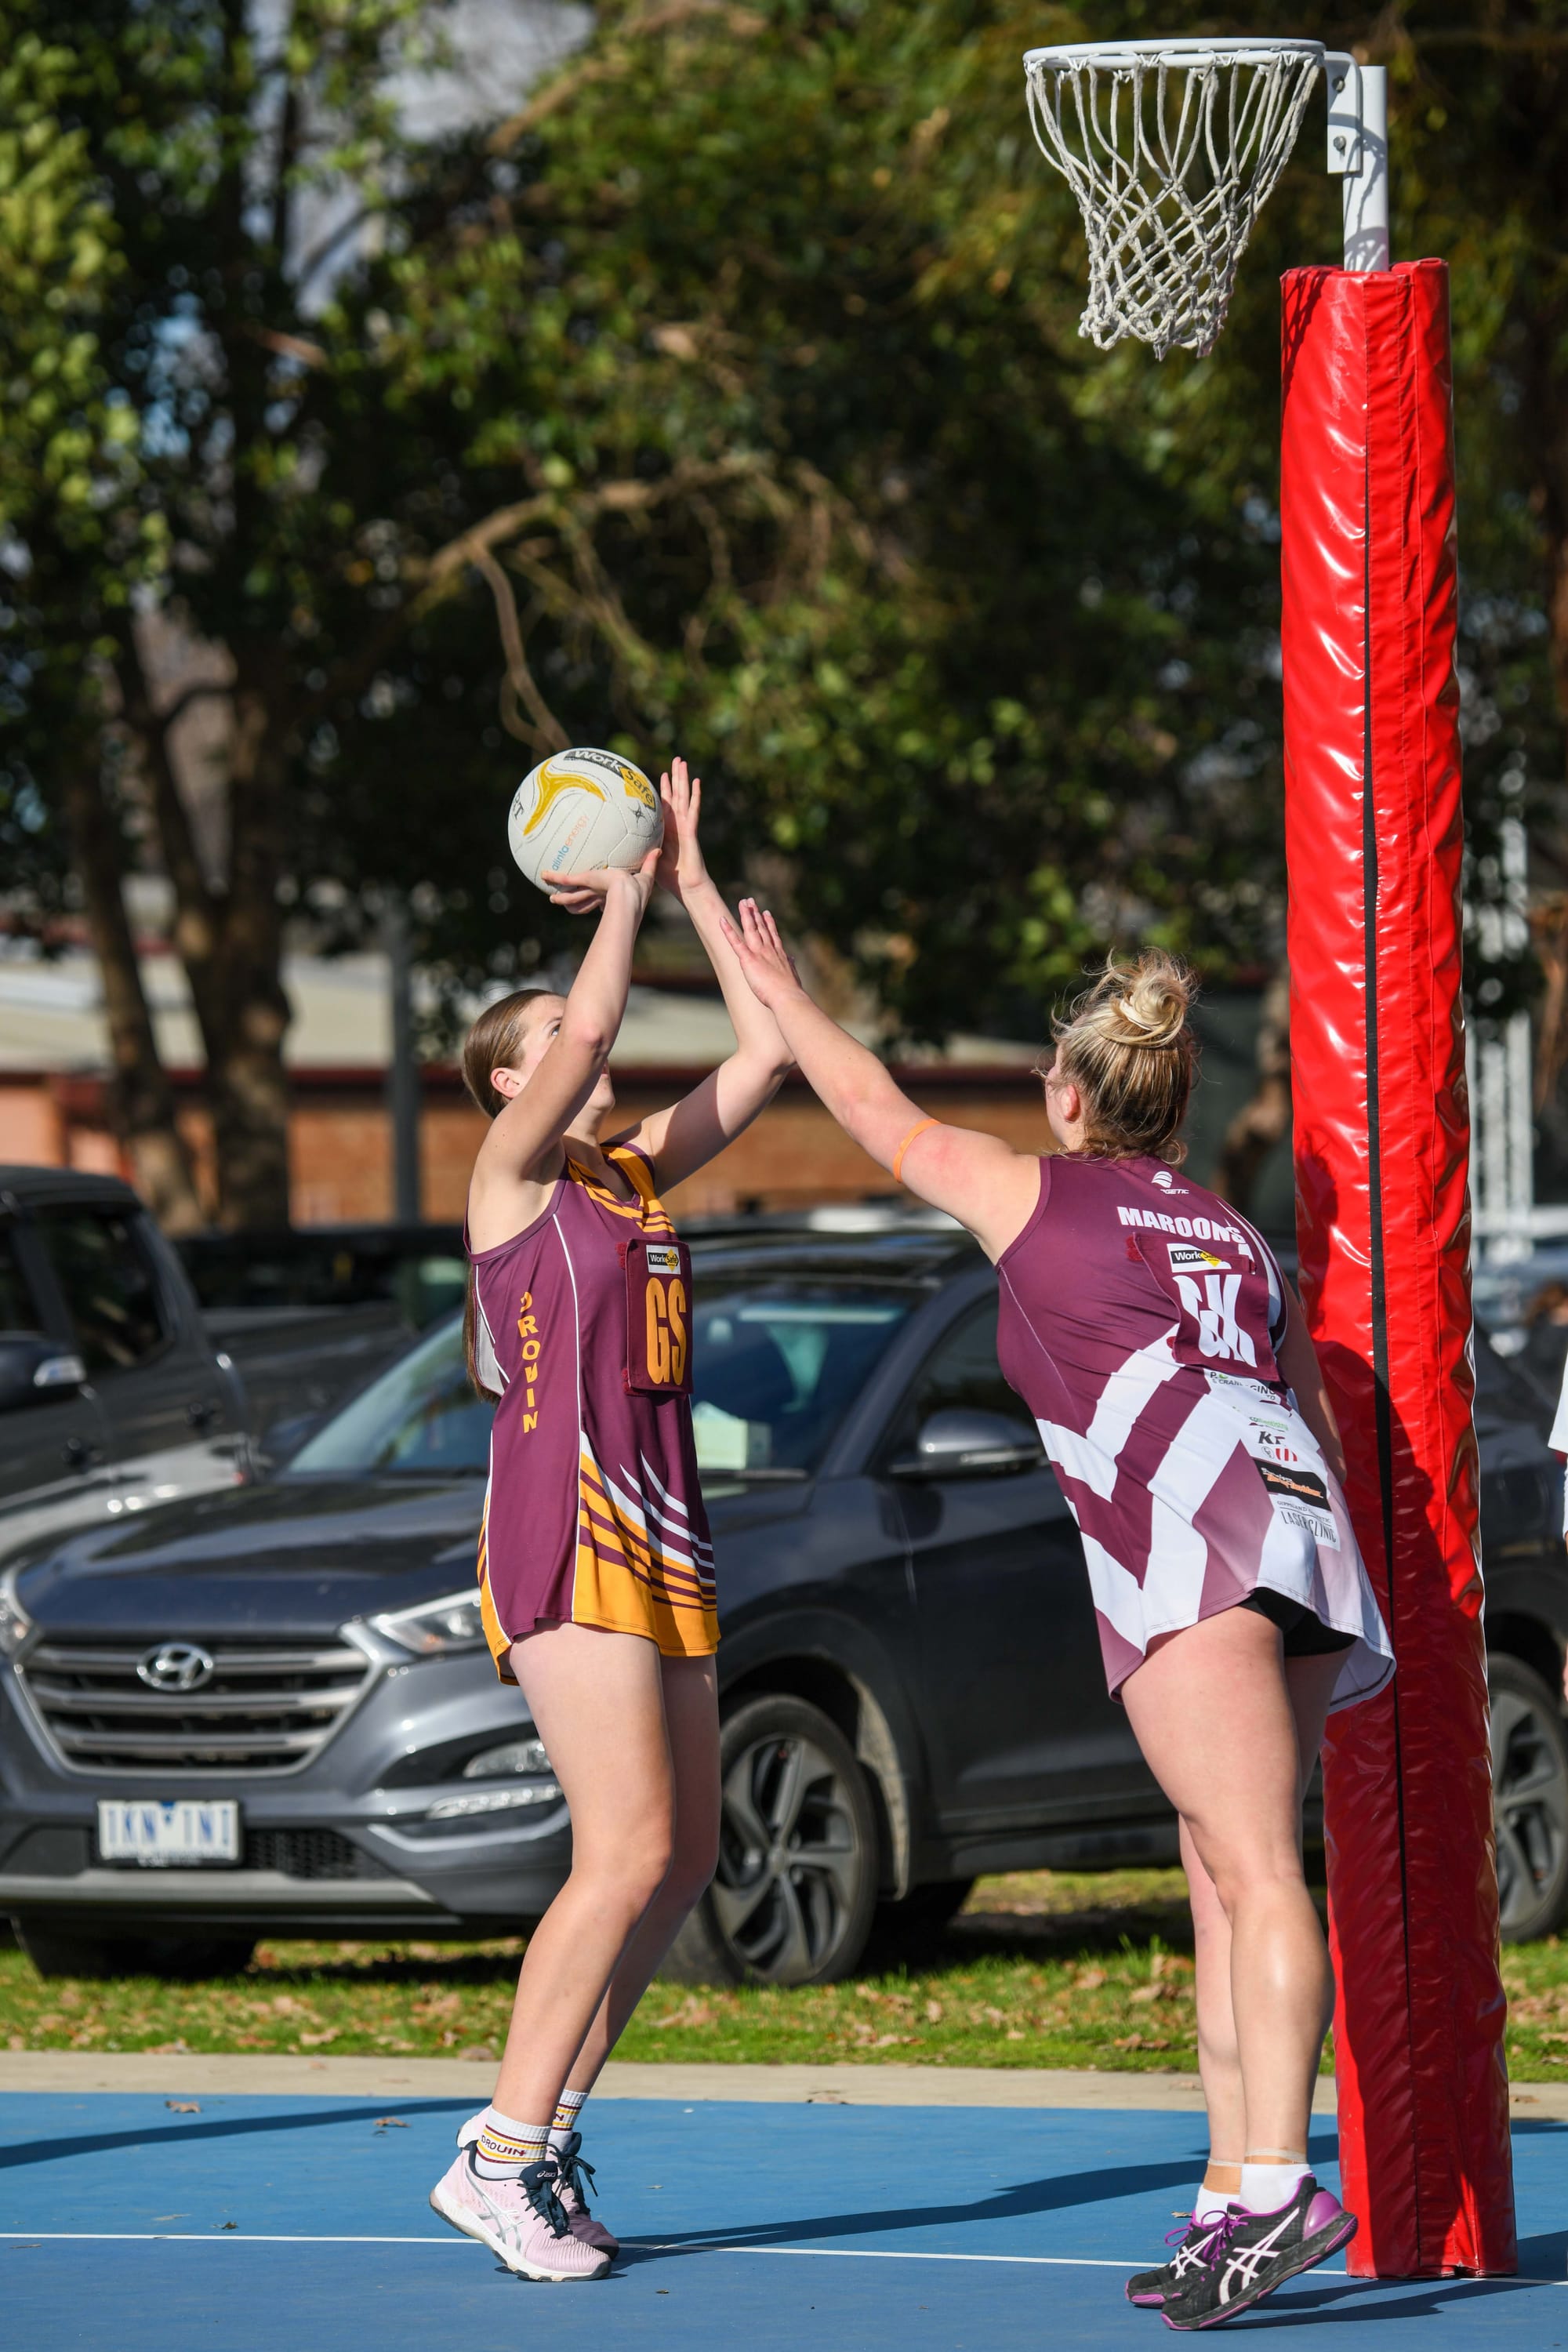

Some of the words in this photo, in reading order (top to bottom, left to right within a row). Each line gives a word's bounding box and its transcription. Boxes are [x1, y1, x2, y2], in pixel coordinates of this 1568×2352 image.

[1117, 1207, 1247, 1243] MAROONS
[646, 1277, 687, 1386] GS
[481, 2135, 526, 2157] DROUIN
